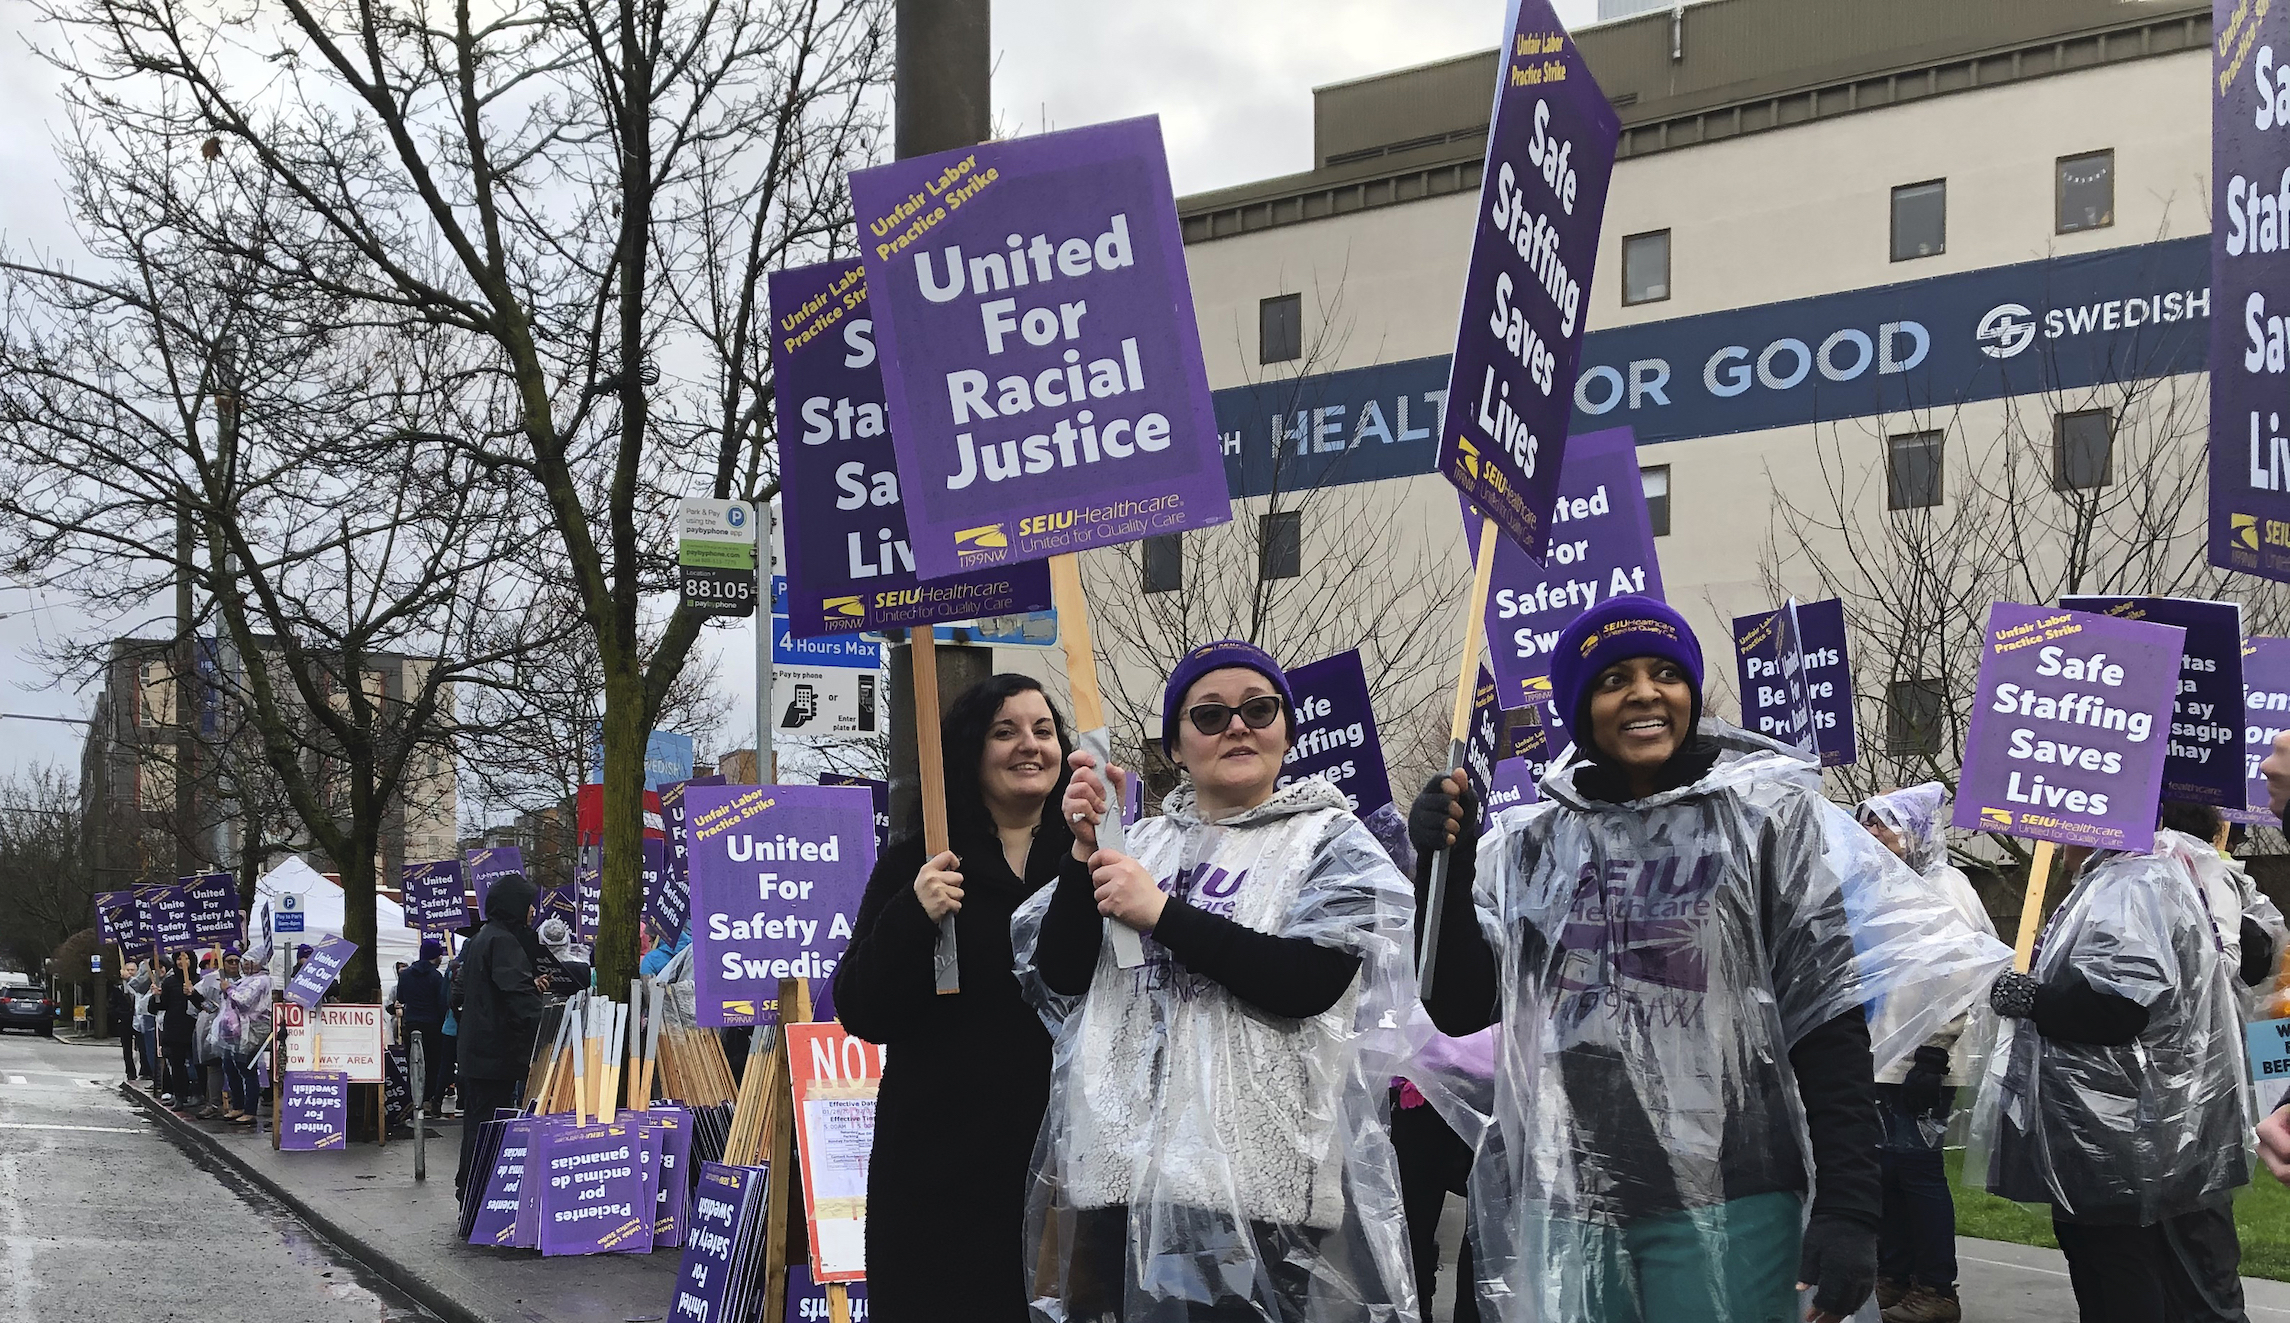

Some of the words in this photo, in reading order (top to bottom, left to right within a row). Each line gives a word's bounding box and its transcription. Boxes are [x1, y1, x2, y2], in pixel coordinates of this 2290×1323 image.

[1516, 32, 1540, 56] Unfair
[1542, 31, 1564, 54] Labor
[1511, 64, 1541, 87] Practice
[1542, 59, 1566, 83] Strike
[1528, 98, 1577, 215] Safe
[870, 191, 926, 237] Unfair
[925, 154, 977, 196] Labor
[875, 206, 947, 261] Practice
[944, 167, 999, 210] Strike
[2226, 174, 2290, 256] Staf
[913, 213, 1135, 302] United
[1492, 161, 1580, 338] Staffing
[780, 291, 828, 332] Unfair
[828, 265, 866, 296] Labo
[980, 298, 1087, 355] For
[2043, 287, 2212, 340] SWEDISH
[783, 306, 843, 354] Practice
[1490, 271, 1555, 397] Saves
[946, 337, 1145, 425] Racial
[1271, 387, 1445, 459] HEALT
[1573, 357, 1672, 415] OR
[1703, 320, 1931, 398] GOOD
[1478, 364, 1538, 479] Lives
[946, 411, 1171, 490] Justice
[708, 508, 720, 517] Pay
[1552, 485, 1609, 523] ted
[686, 527, 729, 536] paybyphone
[1020, 531, 1070, 554] United
[1073, 529, 1093, 543] for
[1096, 516, 1150, 540] Quality
[1151, 510, 1186, 528] Care
[959, 550, 1008, 568] 1199NW
[686, 579, 749, 600] 88105
[1496, 578, 1598, 619] Safety
[1608, 565, 1645, 597] At
[695, 600, 737, 608] paybyphone
[875, 608, 917, 624] United
[917, 605, 934, 618] for
[937, 600, 981, 616] Quality
[984, 596, 1013, 611] Care
[1994, 635, 2044, 654] Practice
[2045, 623, 2083, 640] Strike
[1995, 624, 2035, 640] Unfair
[2036, 612, 2073, 630] Labor
[779, 631, 794, 652] 4
[797, 639, 841, 655] Hours
[845, 641, 875, 656] Max
[779, 671, 791, 680] Pay
[793, 671, 801, 680] by
[802, 672, 823, 680] phone
[2036, 646, 2125, 687] Safe
[1992, 682, 2153, 742] Staffing
[833, 723, 850, 732] plate
[1283, 721, 1365, 765] affing
[2007, 728, 2123, 774] Saves
[2006, 771, 2109, 816] Lives
[694, 805, 730, 827] Unfair
[730, 788, 763, 810] Labor
[695, 815, 741, 841] Practice
[743, 797, 775, 818] Strike
[726, 834, 840, 862] United
[2019, 824, 2050, 839] United
[2066, 832, 2100, 847] Quality
[422, 874, 453, 886] United
[432, 887, 448, 896] For
[758, 873, 813, 900] For
[159, 901, 185, 911] Unite
[193, 888, 225, 899] United
[202, 901, 219, 909] For
[421, 898, 450, 910] Safety
[452, 896, 463, 905] At
[662, 880, 686, 912] Before
[168, 911, 184, 920] For
[190, 911, 222, 922] Safety
[223, 909, 235, 918] At
[425, 907, 462, 919] Swedish
[656, 896, 680, 928] Profits
[157, 922, 187, 932] Safety
[195, 921, 234, 932] Swedish
[708, 912, 818, 946] Safety
[303, 962, 317, 974] For
[315, 967, 332, 981] Our
[314, 951, 340, 968] United
[721, 950, 845, 980] Swedis
[294, 974, 323, 993] Patients
[276, 1006, 302, 1025] NO
[309, 1011, 374, 1025] PARKING
[290, 1043, 299, 1051] TO
[347, 1056, 374, 1064] AREA
[810, 1035, 867, 1089] NO
[292, 1085, 338, 1096] Swedish
[304, 1098, 341, 1109] Safety
[294, 1123, 332, 1133] United
[304, 1110, 323, 1120] For
[551, 1146, 630, 1170] ganancias
[551, 1175, 571, 1189] de
[574, 1166, 631, 1183] encima
[578, 1185, 606, 1201] por
[554, 1202, 632, 1222] Pacientes
[692, 1262, 709, 1288] For
